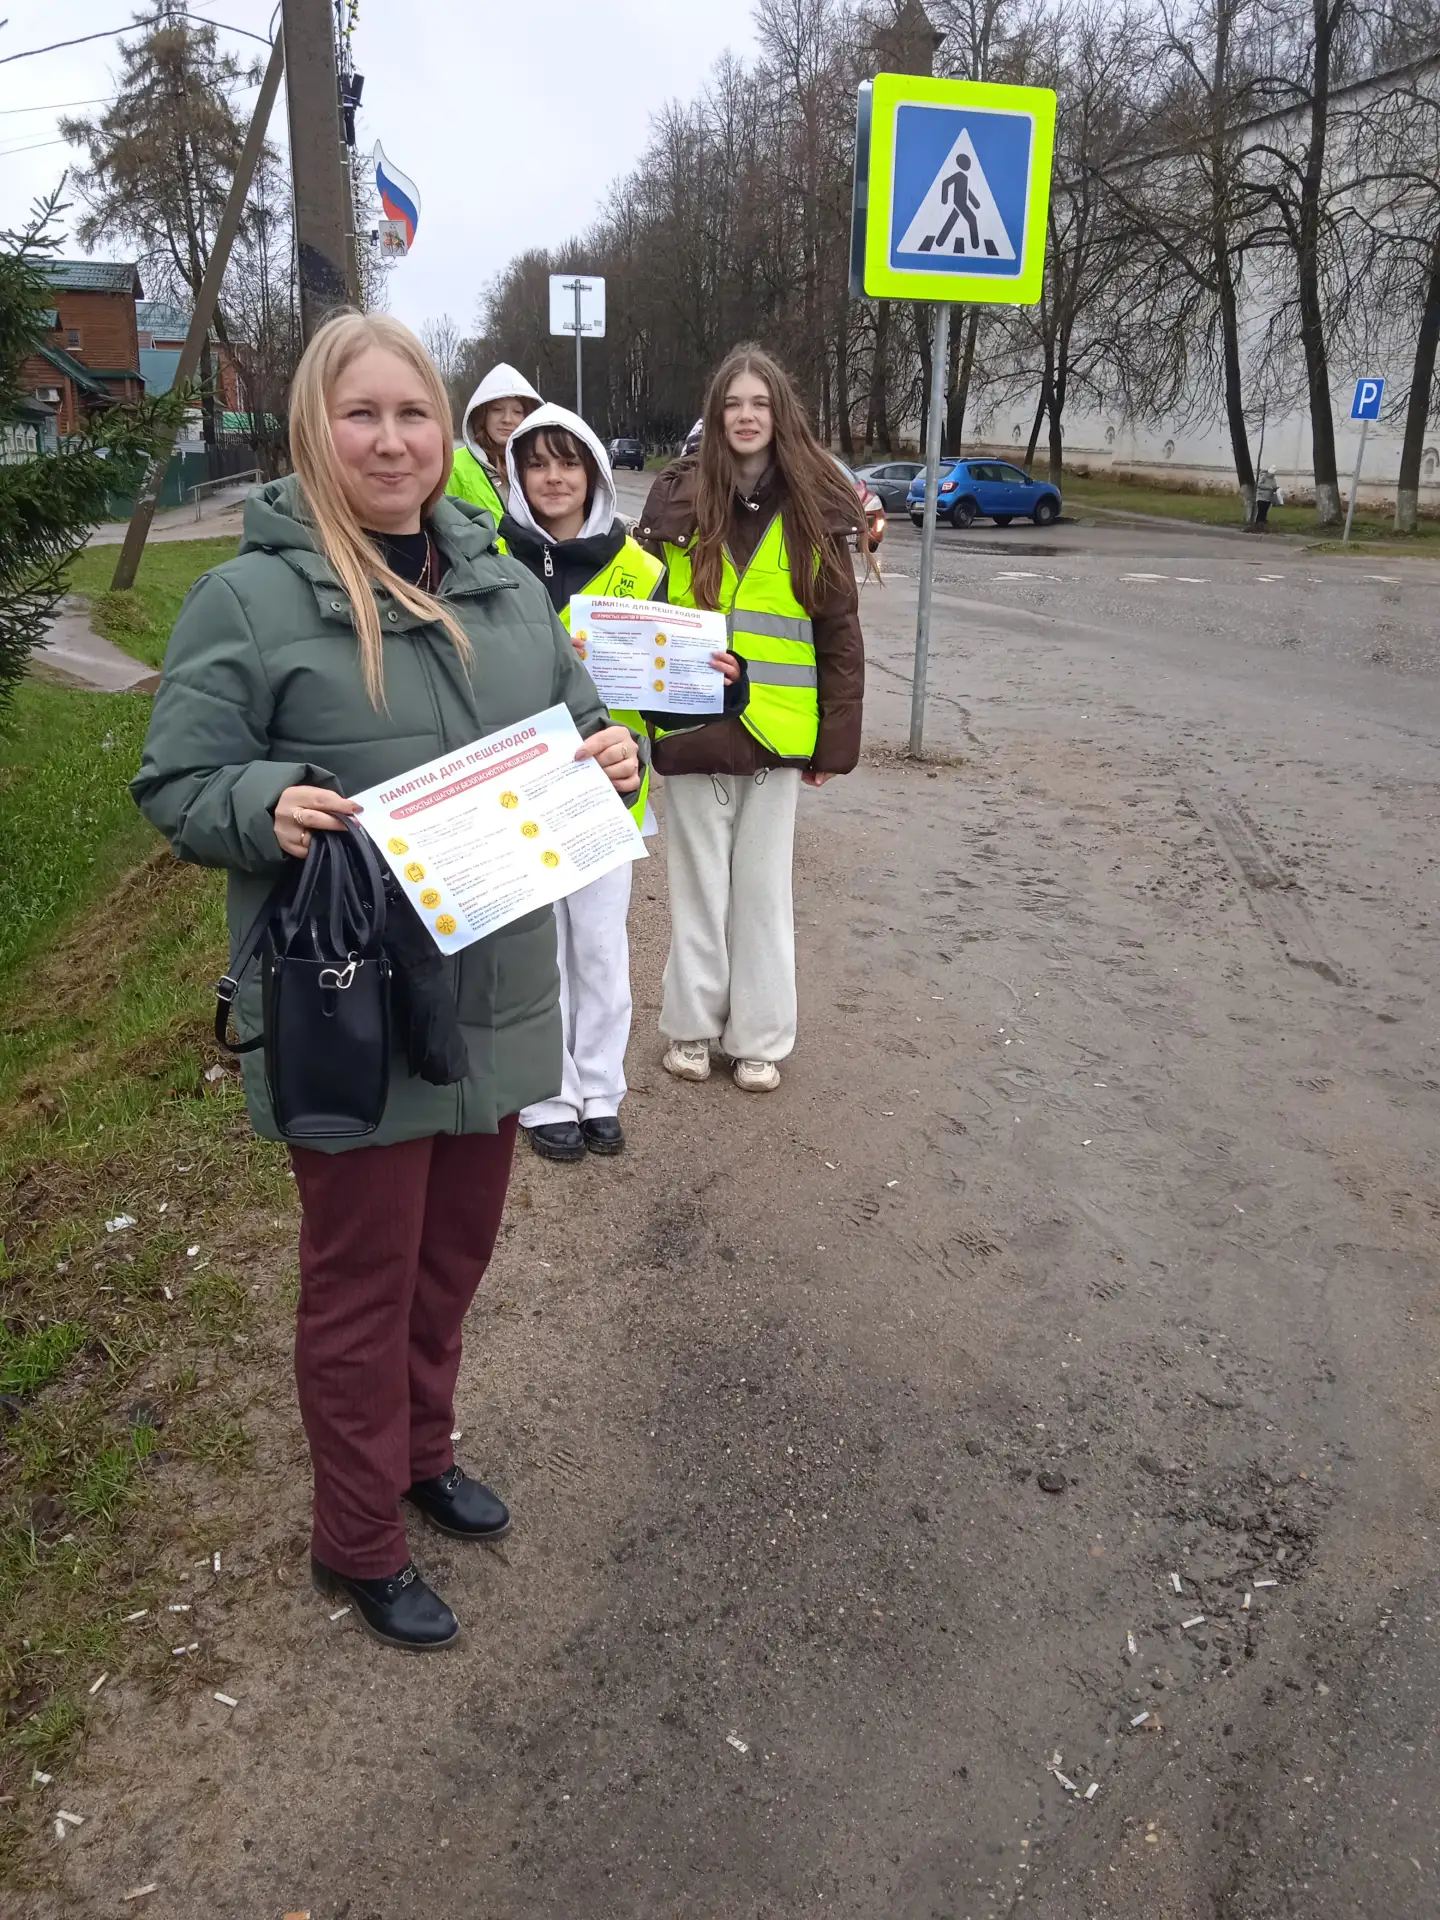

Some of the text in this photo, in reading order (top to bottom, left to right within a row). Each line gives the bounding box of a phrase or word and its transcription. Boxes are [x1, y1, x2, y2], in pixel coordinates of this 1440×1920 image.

[1358, 382, 1377, 414] P
[591, 600, 630, 609] ПАМЯТКА
[379, 727, 537, 804] ПАМЯТКА ДЛЯ ПЕШЕХОДОВ
[405, 797, 435, 816] ПРОСТЫХ
[434, 788, 456, 803] ШАГОВ
[460, 766, 506, 791] БЕЗОПАСНОСТИ
[504, 748, 540, 770] ПЕШЕХОДОВ
